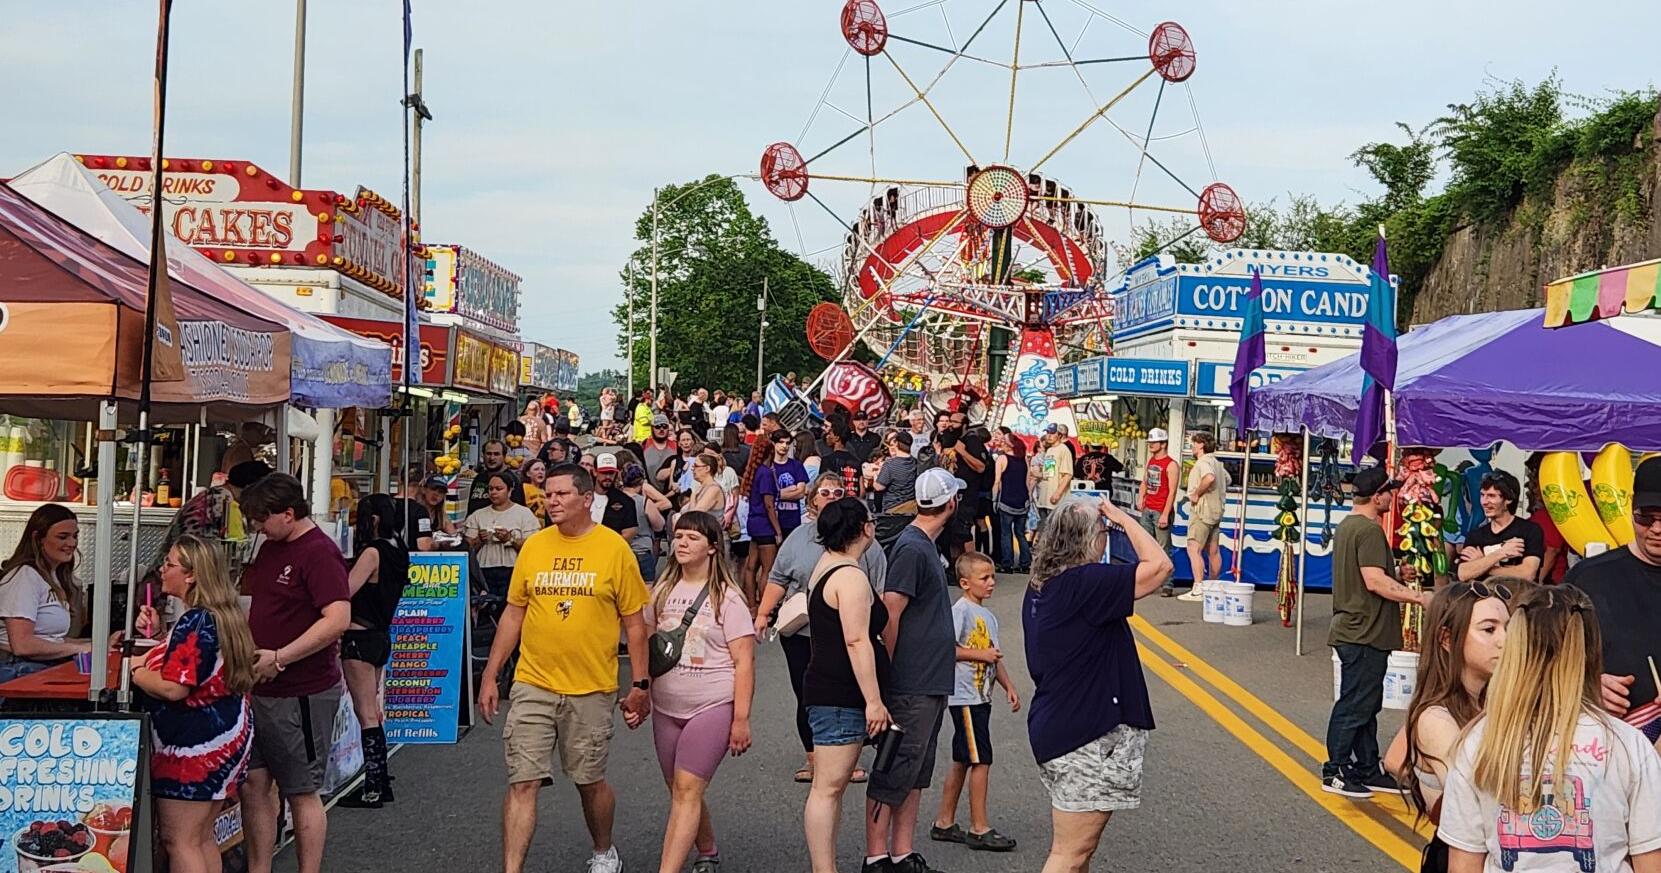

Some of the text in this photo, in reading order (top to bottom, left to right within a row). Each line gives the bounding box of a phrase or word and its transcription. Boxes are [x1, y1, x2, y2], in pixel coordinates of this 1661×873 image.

[148, 177, 216, 195] RINKS
[174, 206, 294, 248] CAKES
[1246, 263, 1329, 278] MYERS
[1193, 284, 1294, 314] COTON
[1300, 289, 1370, 318] CAND
[1110, 366, 1136, 383] COLD
[1140, 368, 1183, 386] DRINKS
[553, 558, 584, 571] EAST
[408, 564, 460, 585] ONADE
[534, 571, 597, 588] FAIRMONT
[535, 586, 596, 597] BASKETBALL
[397, 609, 428, 617] PLAIN
[398, 626, 453, 634] RASPBERRY
[392, 652, 431, 660] CHERRY
[391, 661, 428, 669] MANGO
[385, 679, 432, 687] COCONUT
[385, 710, 430, 718] TROPICAL
[386, 728, 439, 738] off Refills
[0, 722, 103, 759] COLD
[0, 757, 137, 787] FRESHING
